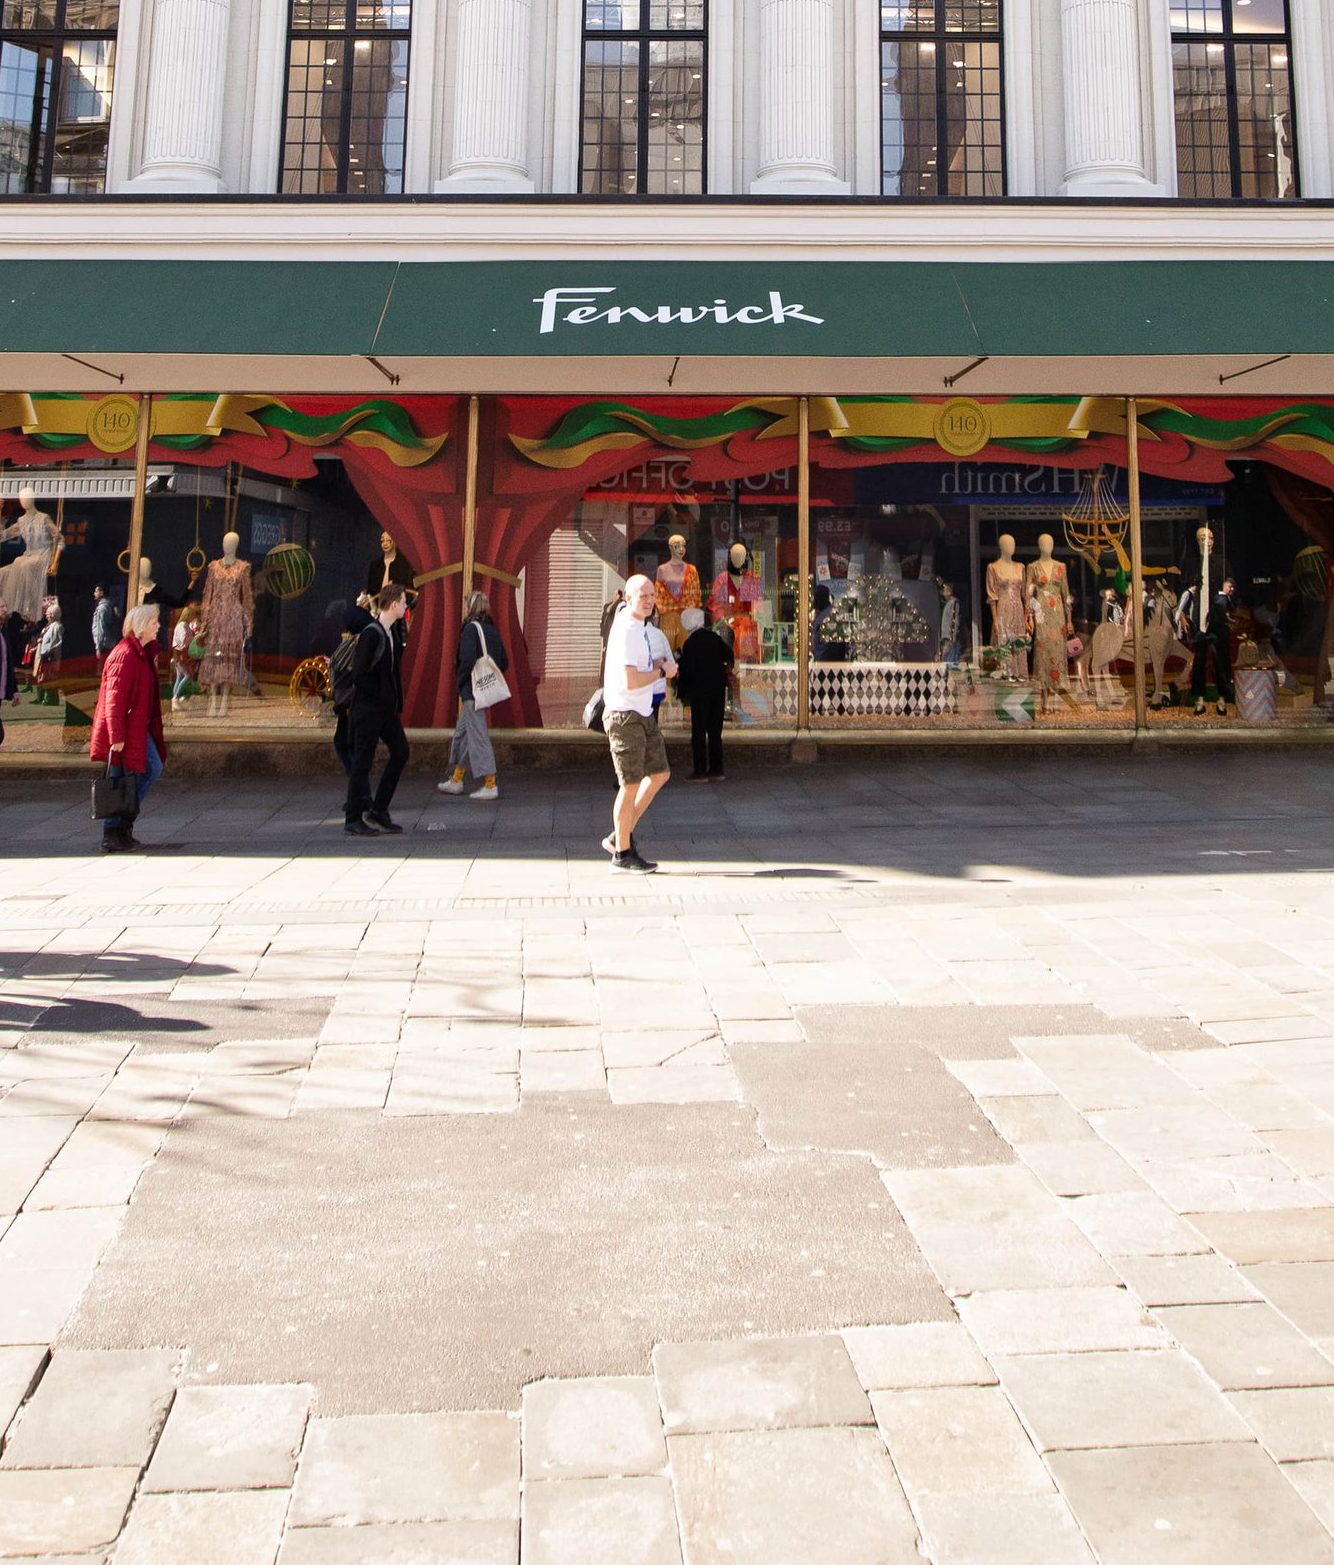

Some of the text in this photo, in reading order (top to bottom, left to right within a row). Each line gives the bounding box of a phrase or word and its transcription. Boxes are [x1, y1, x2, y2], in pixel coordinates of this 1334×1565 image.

[532, 287, 825, 334] Fenwick
[103, 413, 130, 428] 140
[950, 416, 977, 432] 140
